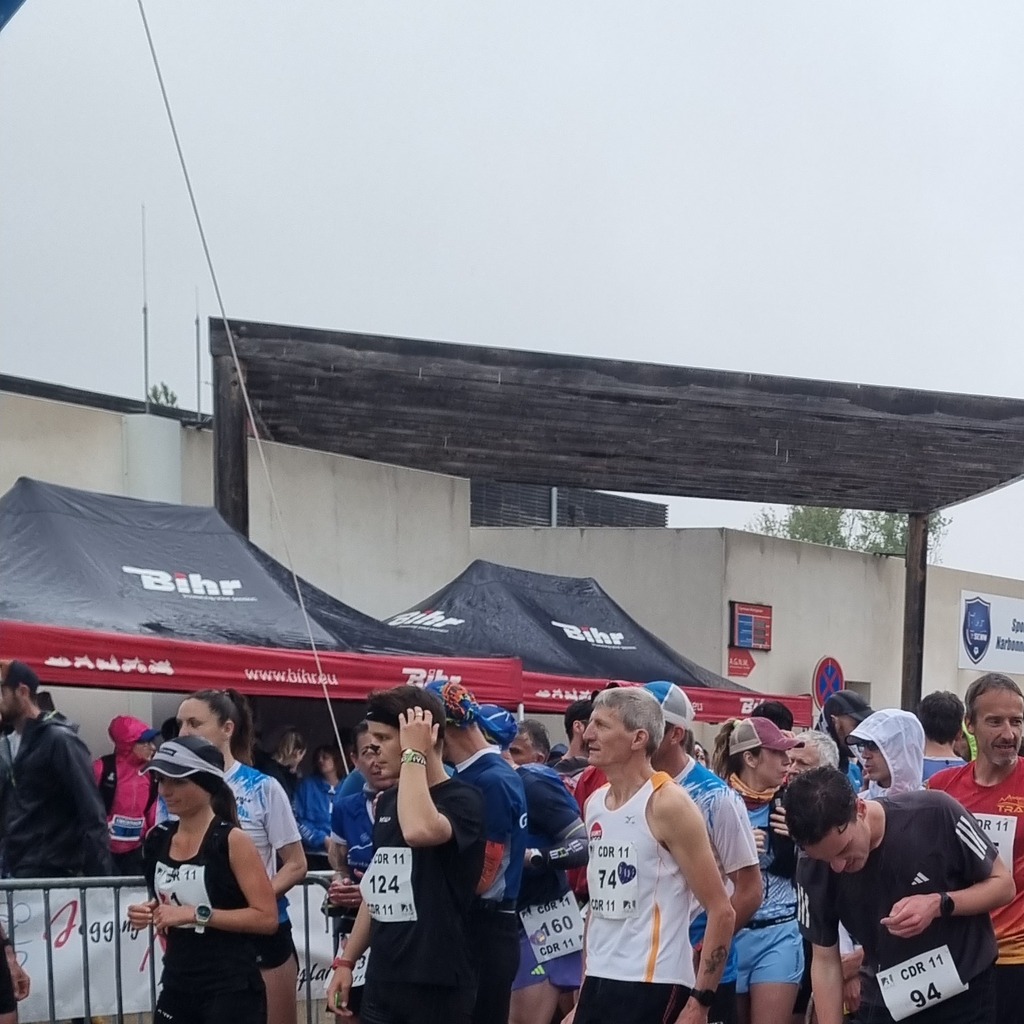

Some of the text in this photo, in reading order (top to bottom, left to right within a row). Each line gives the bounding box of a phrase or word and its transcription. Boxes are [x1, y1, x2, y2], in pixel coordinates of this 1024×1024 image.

[122, 566, 242, 596] Bihr
[387, 609, 465, 628] Bihr
[551, 620, 624, 645] Bihr
[244, 666, 338, 686] www.bihr.eu
[996, 821, 1008, 832] 11
[393, 853, 405, 865] 11
[598, 846, 630, 858] CDR 11
[184, 870, 197, 881] 11
[369, 875, 400, 894] 124
[599, 869, 617, 889] 74
[382, 904, 394, 915] 11
[537, 900, 557, 915] CDR
[606, 900, 616, 912] 11
[540, 915, 574, 937] 160
[539, 938, 575, 957] CDR 11
[900, 953, 945, 981] CDR 11
[909, 981, 942, 1008] 94
